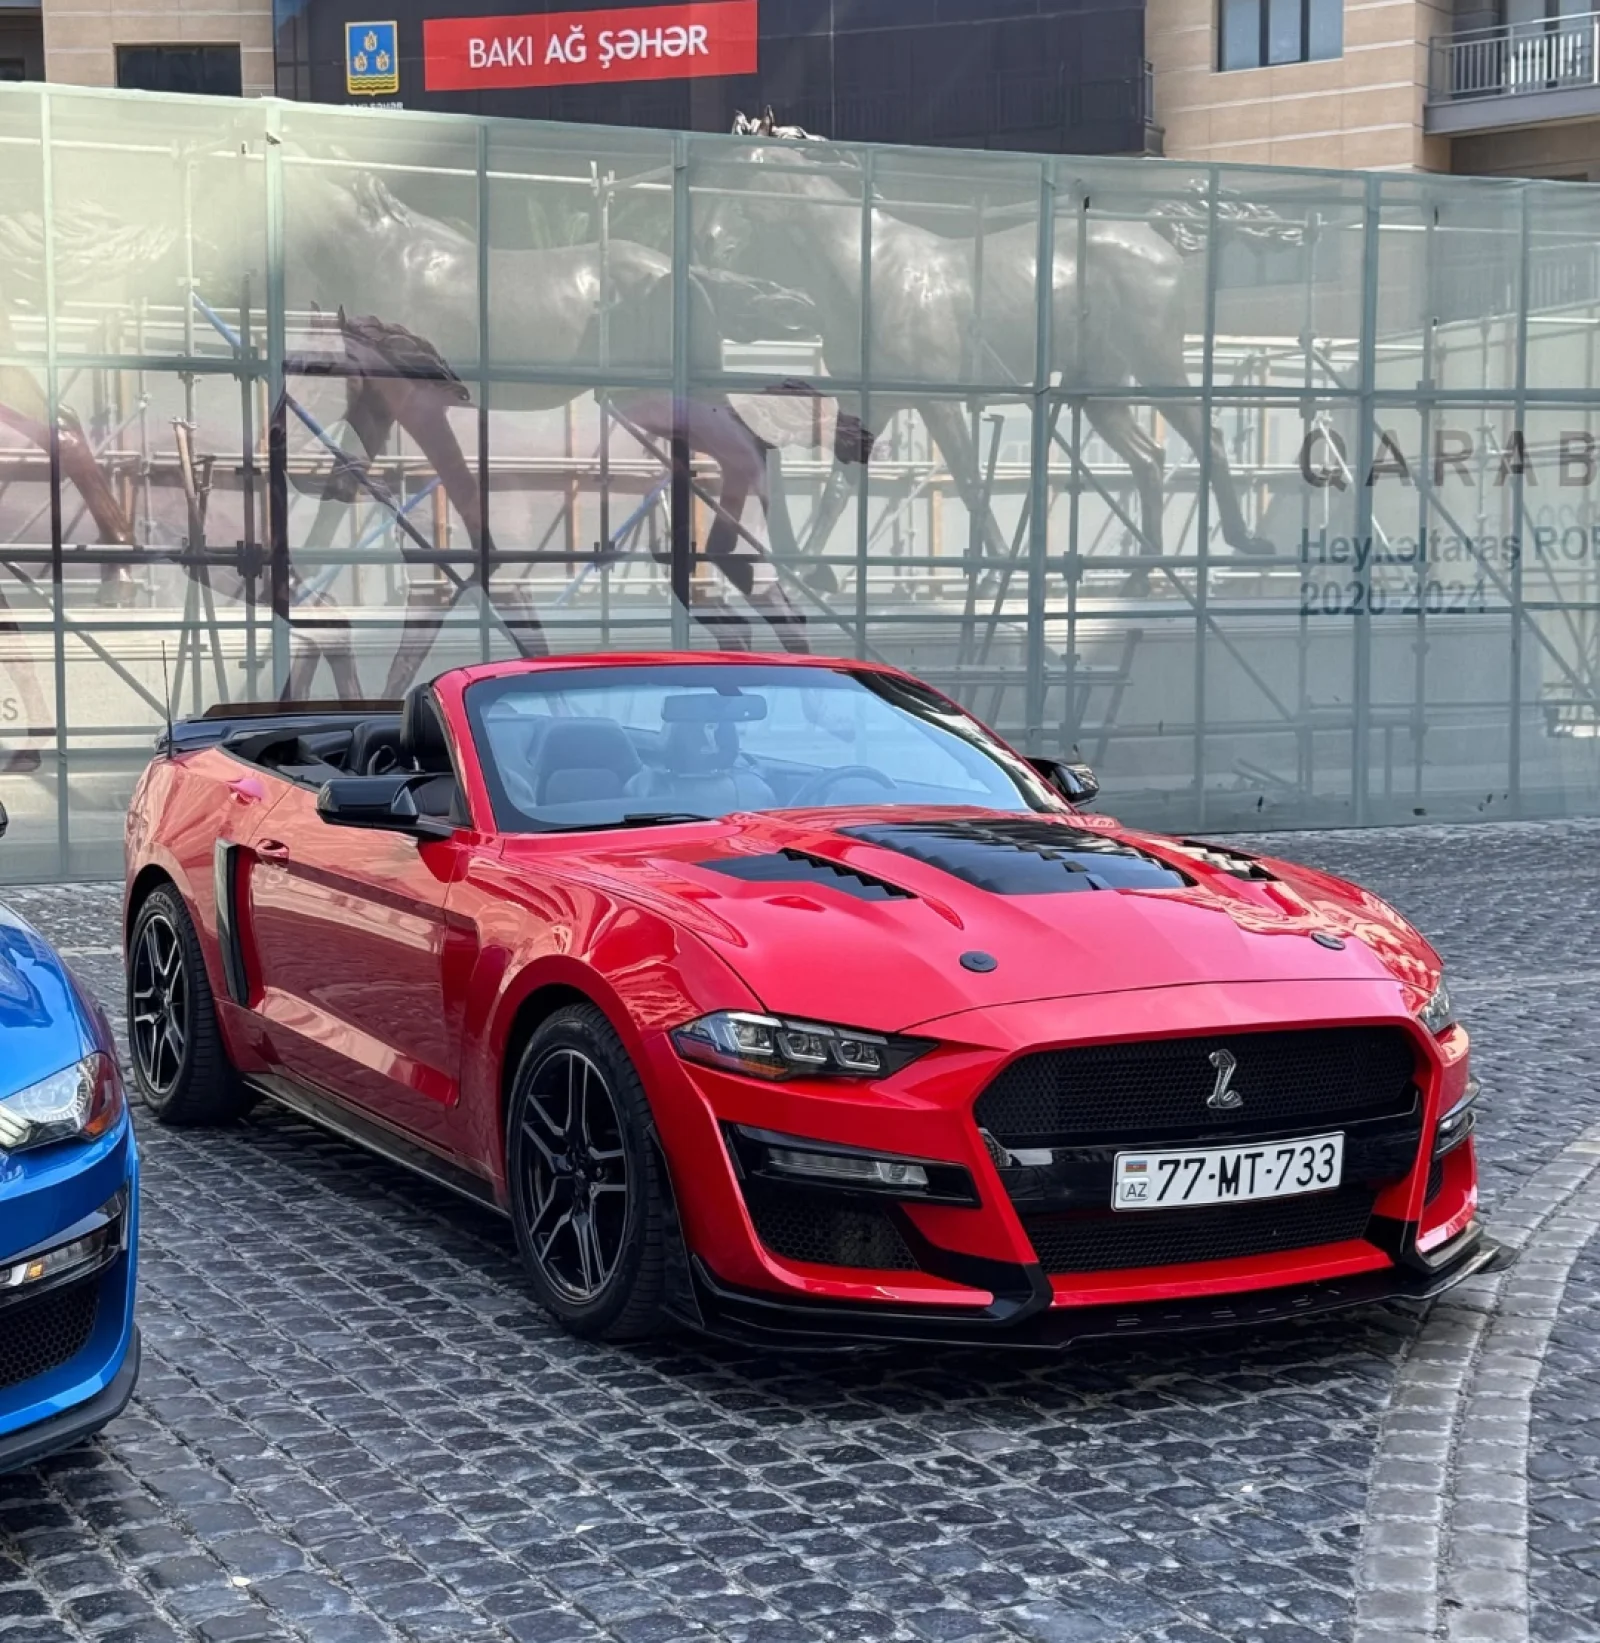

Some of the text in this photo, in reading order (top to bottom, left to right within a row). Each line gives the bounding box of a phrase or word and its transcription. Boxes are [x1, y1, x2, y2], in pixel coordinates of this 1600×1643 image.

[469, 24, 709, 69] BAKI AĞ ŞƏHƏR
[1300, 428, 1600, 492] QARAB
[1125, 1182, 1148, 1199] AZ
